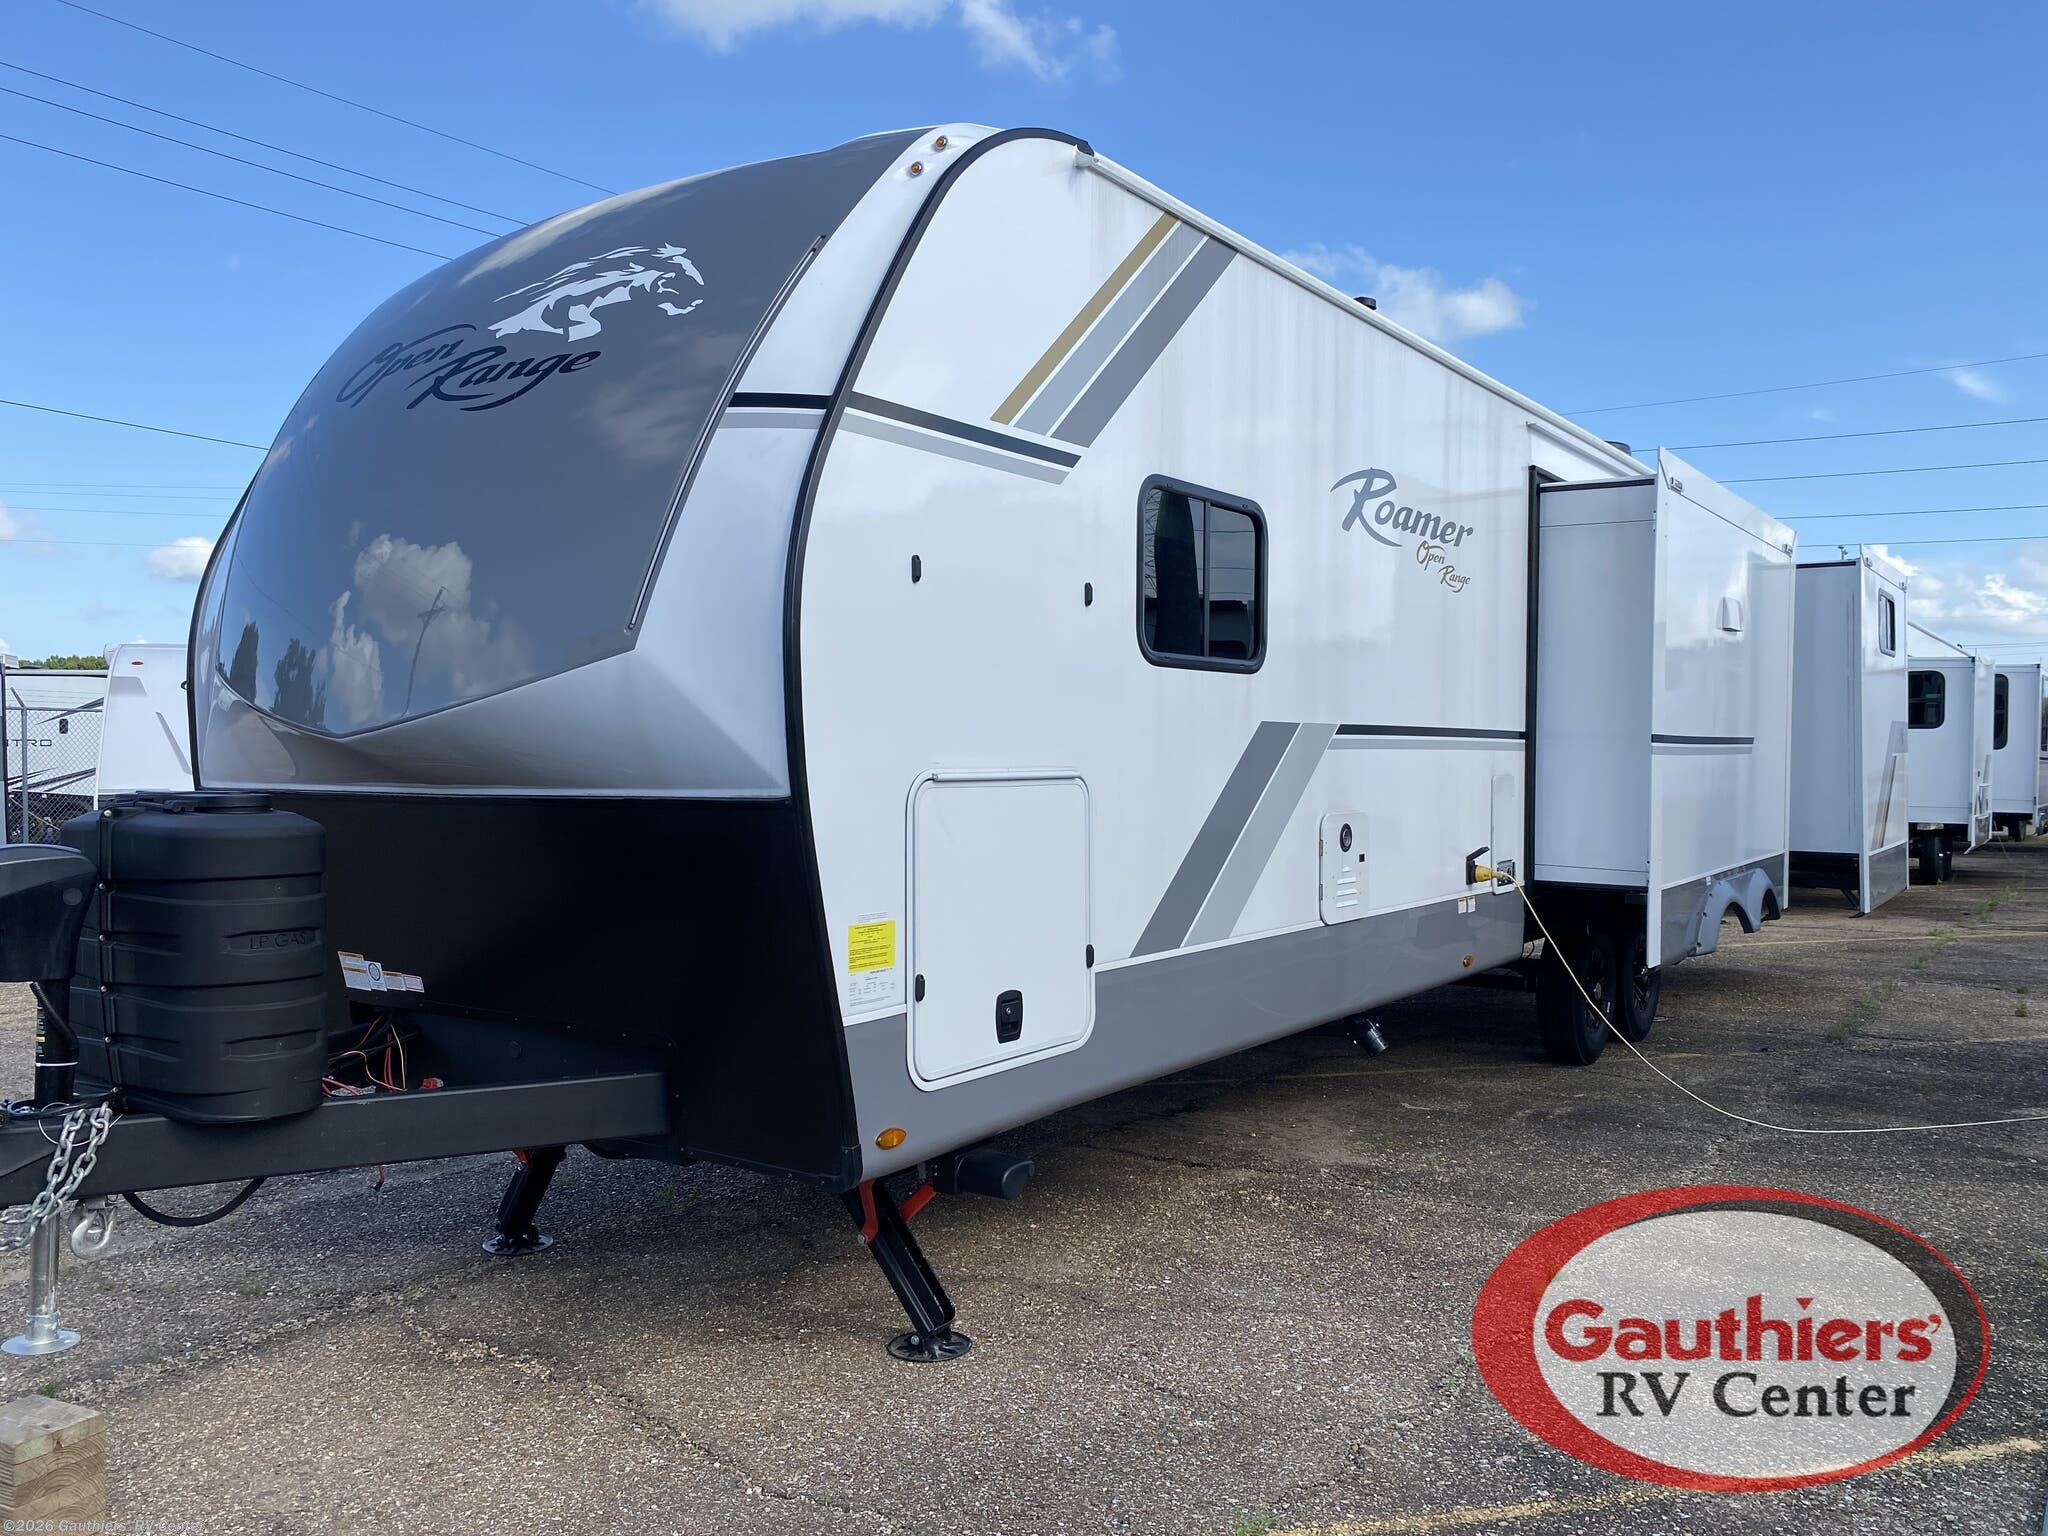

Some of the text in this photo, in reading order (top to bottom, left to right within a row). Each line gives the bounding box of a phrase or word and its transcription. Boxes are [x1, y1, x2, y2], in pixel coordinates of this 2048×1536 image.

[336, 323, 477, 408] Open
[404, 345, 602, 411] Range
[1330, 467, 1474, 548] Roamer
[1416, 540, 1447, 571] Open
[1438, 565, 1471, 593] Range
[275, 931, 306, 948] GAS
